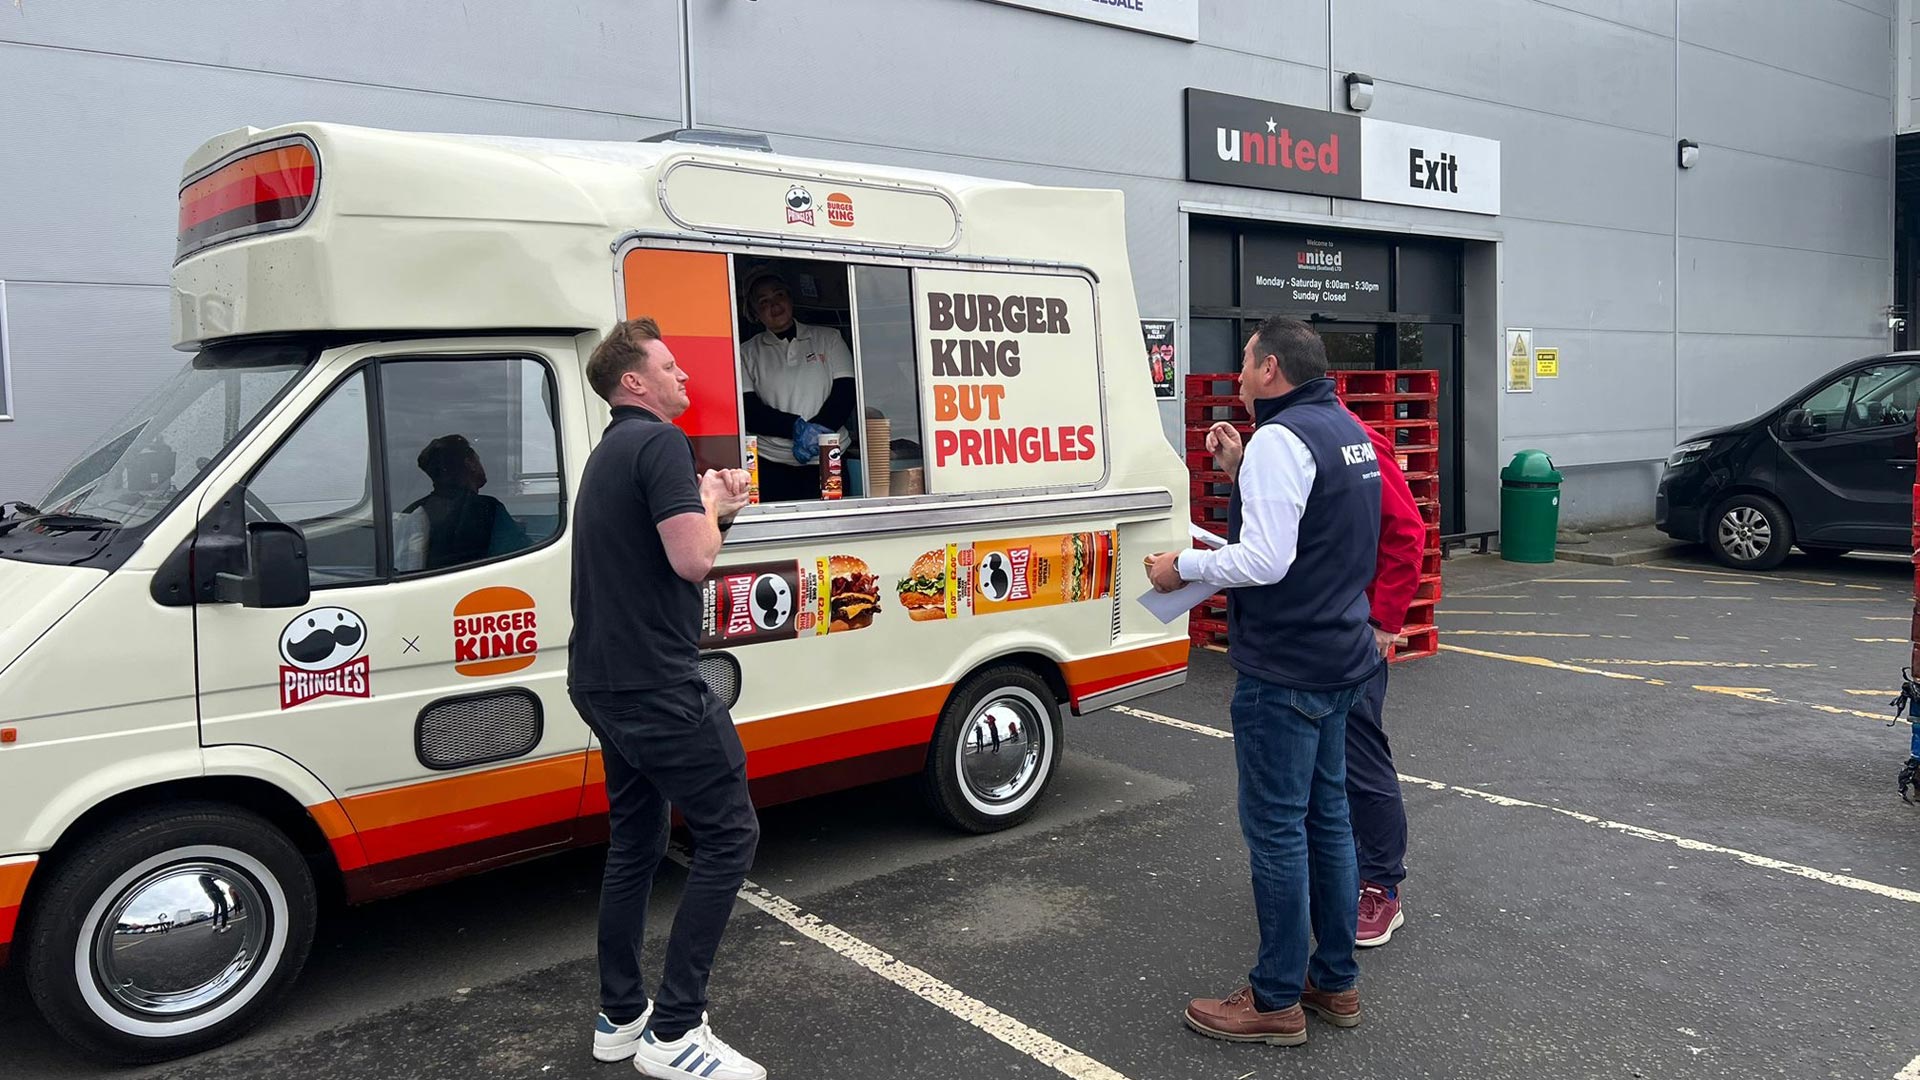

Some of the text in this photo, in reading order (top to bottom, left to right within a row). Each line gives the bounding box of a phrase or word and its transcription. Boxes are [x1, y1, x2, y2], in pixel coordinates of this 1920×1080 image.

[1216, 118, 1339, 175] united
[1409, 148, 1458, 194] Exit
[788, 210, 813, 223] PRINGLES
[827, 202, 853, 211] BURGER
[828, 209, 854, 221] KING
[1297, 250, 1342, 266] united
[1306, 238, 1327, 247] Welcome
[1256, 276, 1285, 288] Monday
[1290, 277, 1322, 290] Saturday
[1325, 280, 1350, 290] 6:00am
[1355, 281, 1379, 293] 5:30pm
[1292, 290, 1347, 302] Sunday Closed
[927, 292, 1071, 334] BURGER
[930, 339, 1021, 377] KING
[933, 384, 1006, 421] BUT
[935, 425, 1096, 467] PRINGLES
[1010, 549, 1029, 599] PRINGLES
[708, 580, 716, 636] BACON DOUBLE
[728, 576, 752, 634] PRINGLES
[454, 612, 537, 637] BURGER
[702, 619, 709, 630] XL
[455, 631, 538, 662] KING
[285, 662, 365, 704] PRINGLES
